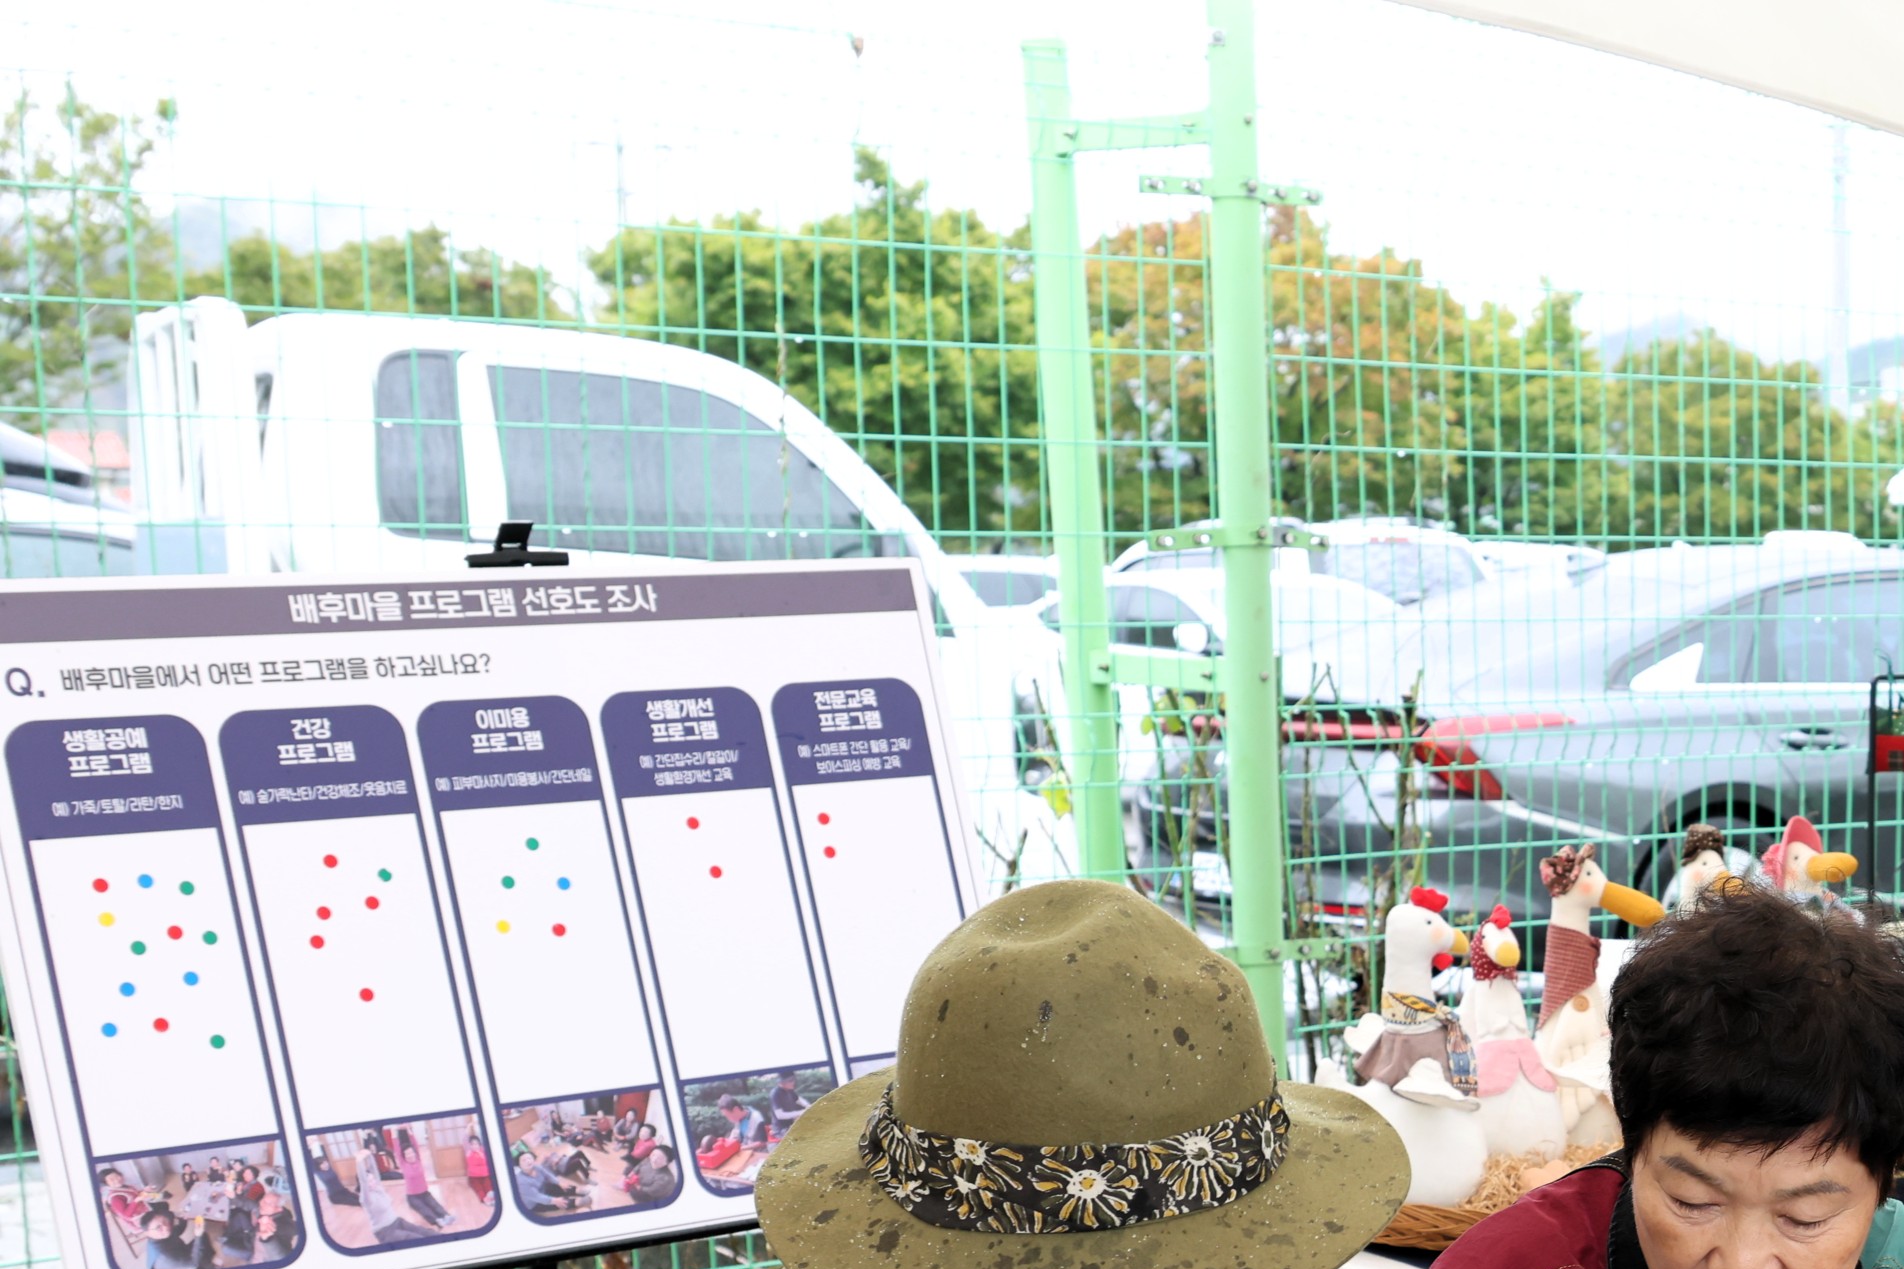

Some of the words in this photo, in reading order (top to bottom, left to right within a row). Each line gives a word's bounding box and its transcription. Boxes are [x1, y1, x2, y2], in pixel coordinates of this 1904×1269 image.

[288, 590, 402, 624] 배후마을
[408, 588, 517, 620] 프로그램
[521, 585, 601, 617] 선호도
[605, 583, 658, 613] 조사
[5, 667, 45, 698] Q.
[60, 663, 201, 691] 배후마을에서
[208, 661, 252, 686] 어떤
[260, 657, 369, 683] 프로그램을
[373, 652, 491, 679] 하고싶나요?
[645, 698, 715, 720] 생활개선
[813, 688, 878, 711] 전문교육
[290, 718, 332, 740] 건강
[475, 707, 530, 729] 이미용
[818, 710, 883, 732] 프로그램
[62, 727, 149, 752] 생활공예
[471, 730, 545, 753] 프로그램
[650, 720, 719, 742] 프로그램
[68, 752, 153, 777] 프로그램
[277, 741, 356, 765] 프로그램
